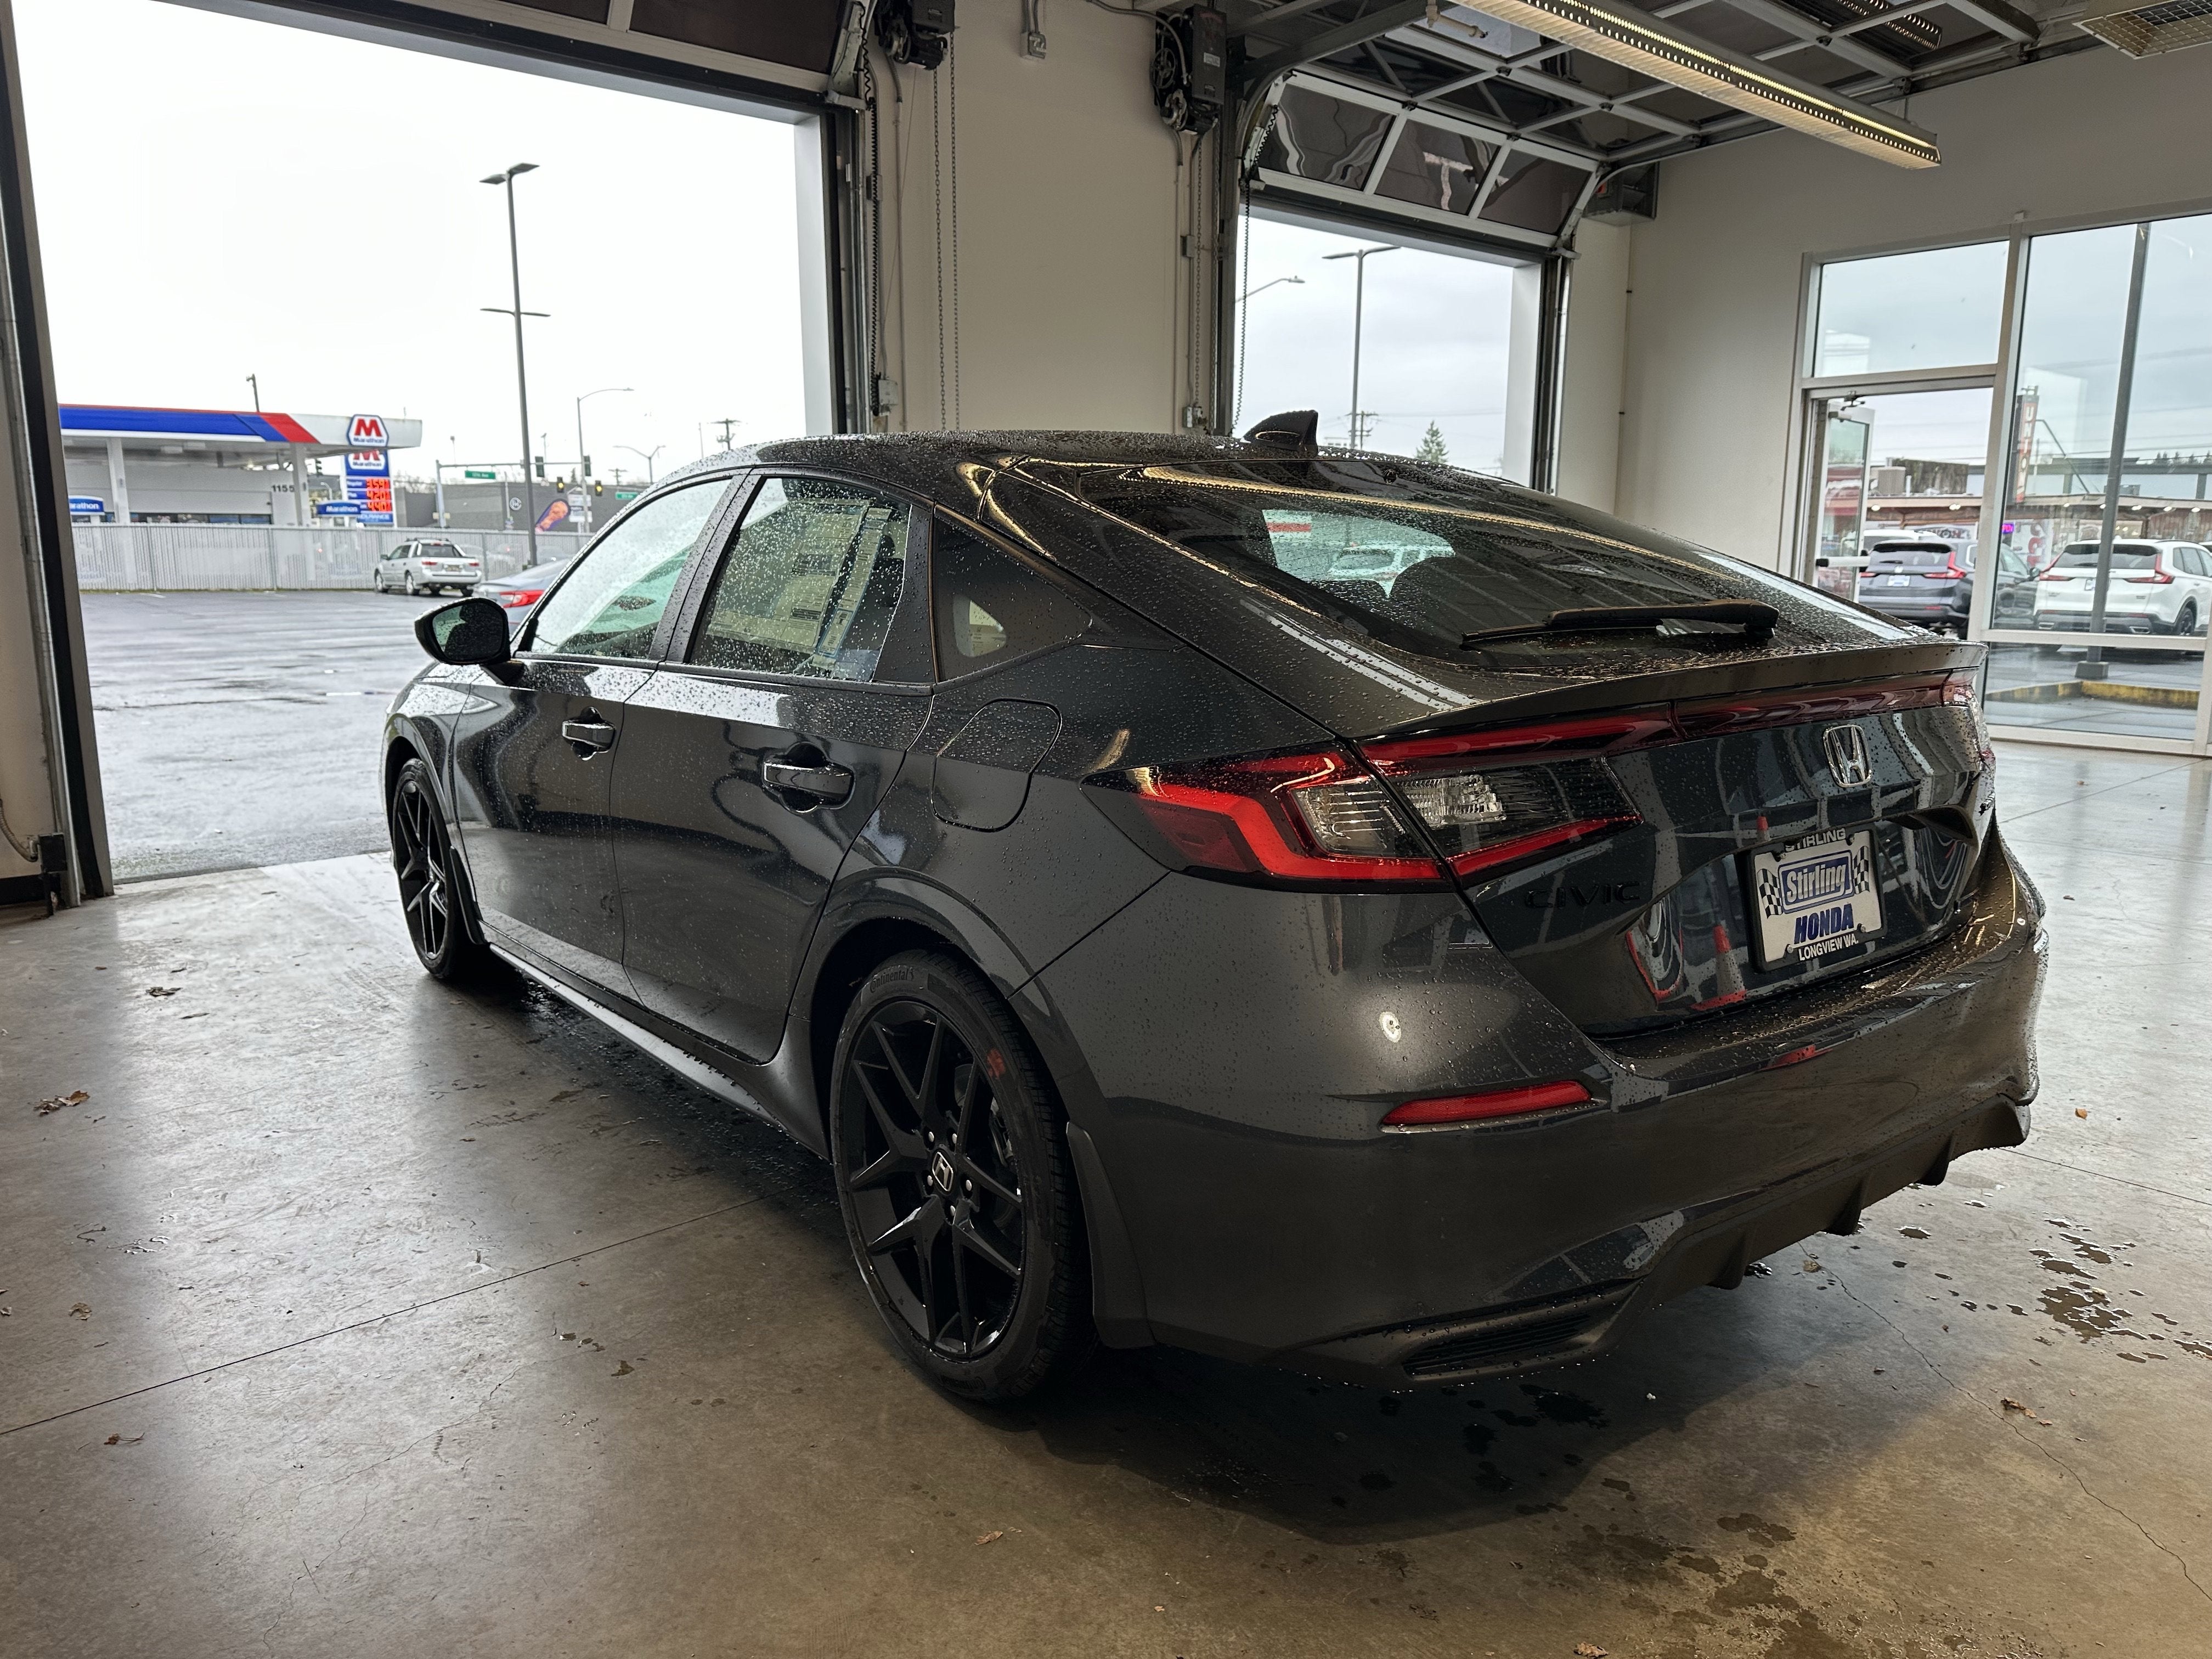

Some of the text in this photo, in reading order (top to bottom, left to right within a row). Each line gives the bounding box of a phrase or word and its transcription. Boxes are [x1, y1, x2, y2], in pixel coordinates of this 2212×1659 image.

[354, 419, 382, 437] M
[70, 501, 99, 510] arathon
[1525, 880, 1641, 909] CIVIC
[1786, 863, 1847, 903] Stirling
[1793, 903, 1854, 945] HONDA
[1798, 937, 1843, 961] LONGVIEW
[870, 969, 909, 993] Continental
